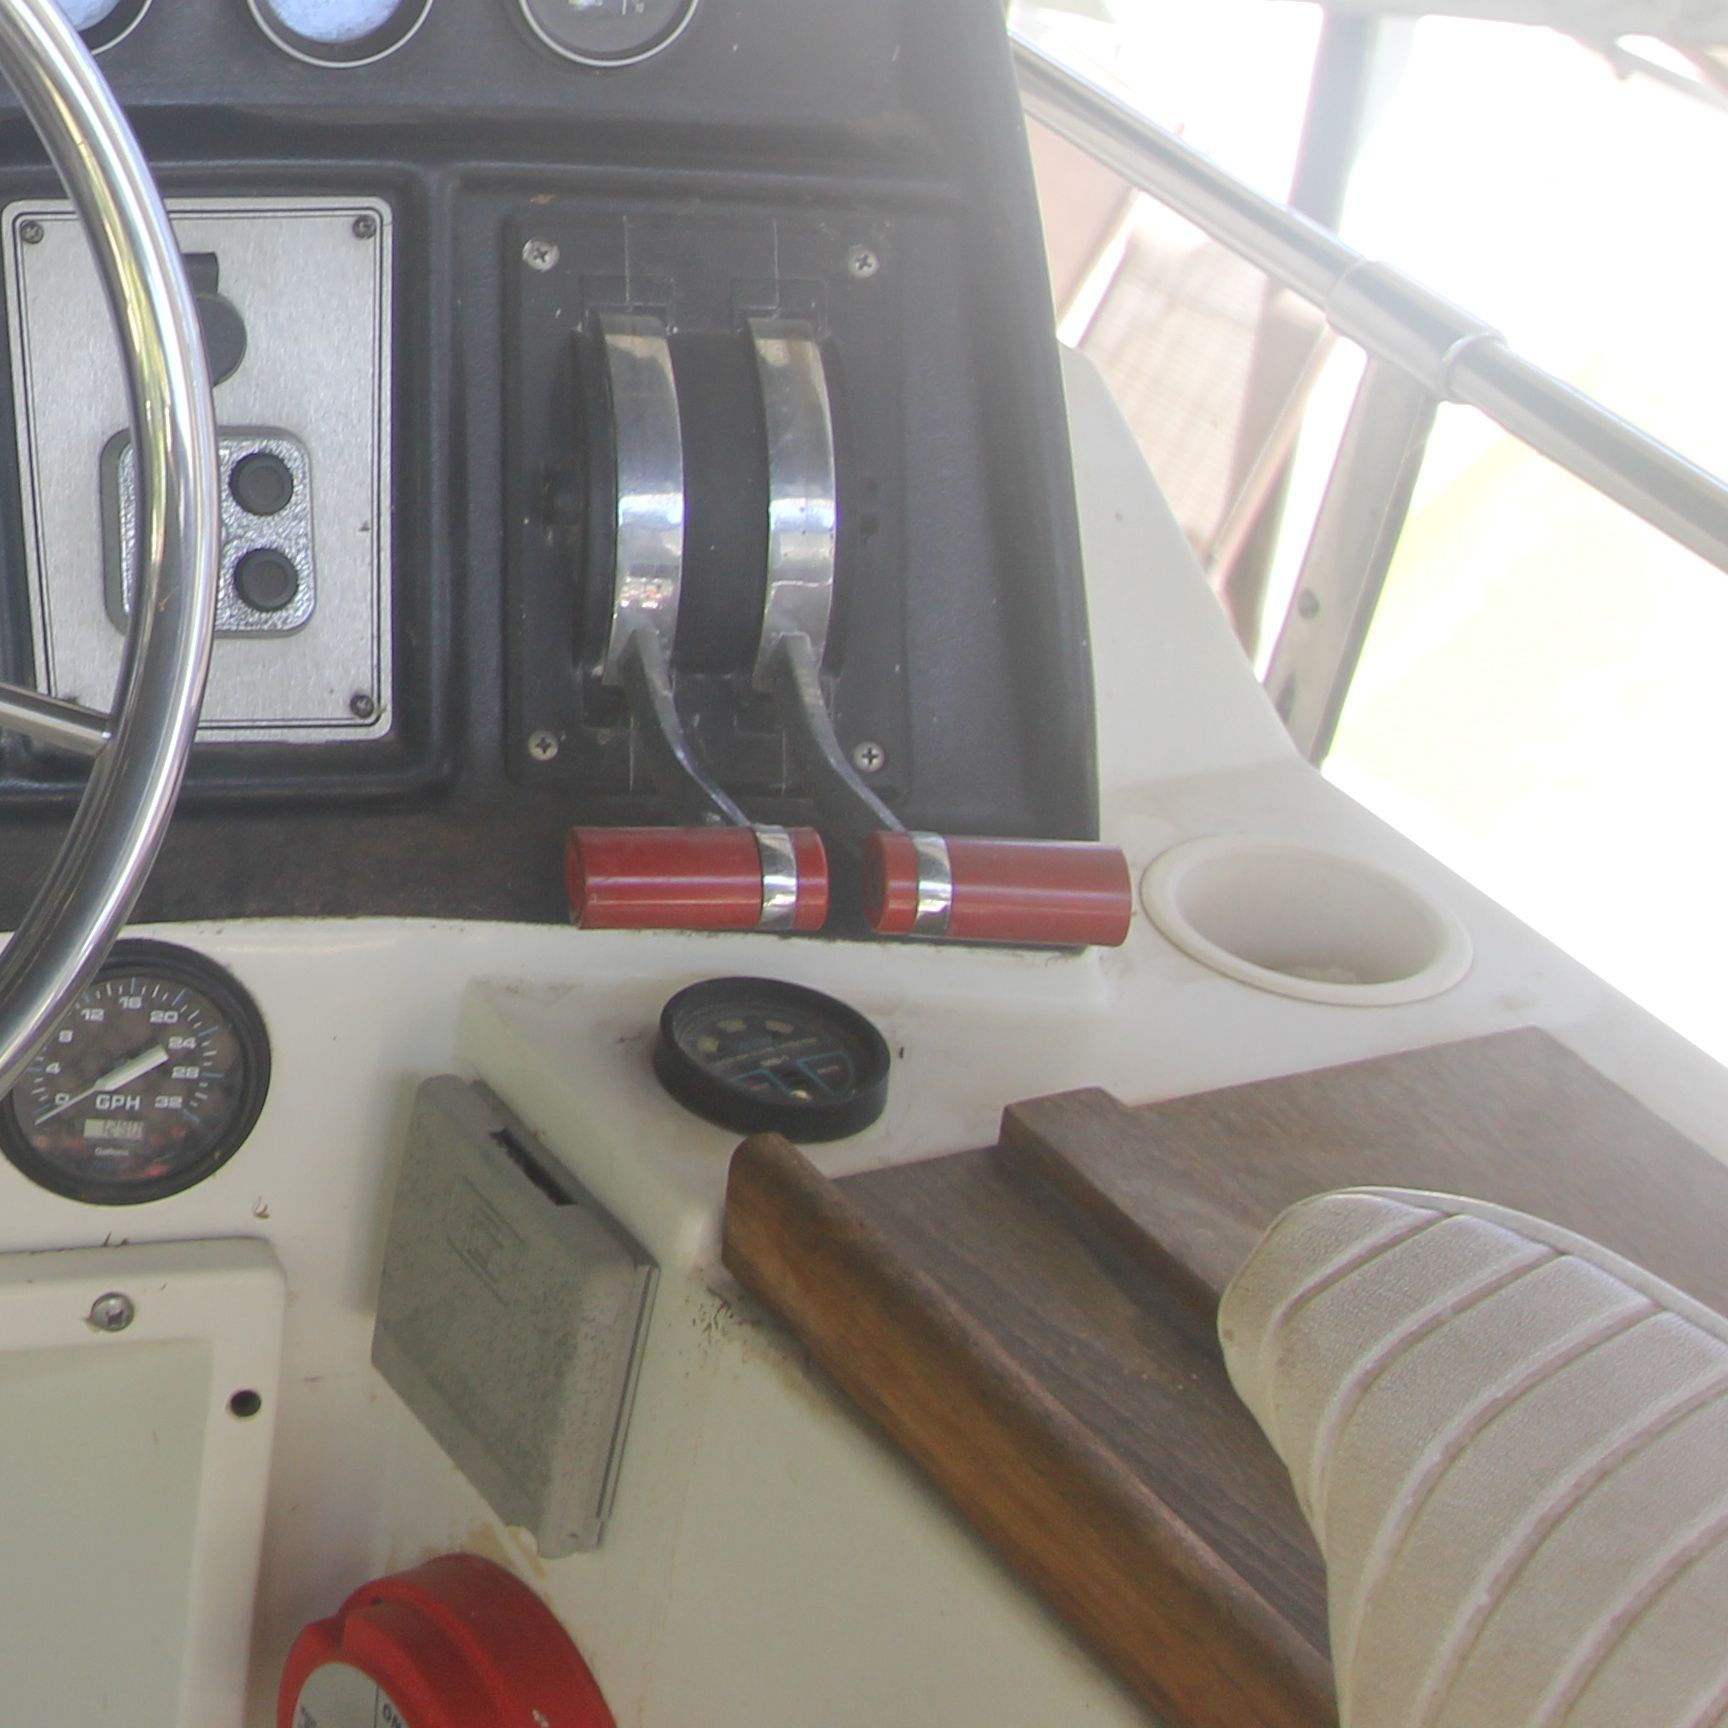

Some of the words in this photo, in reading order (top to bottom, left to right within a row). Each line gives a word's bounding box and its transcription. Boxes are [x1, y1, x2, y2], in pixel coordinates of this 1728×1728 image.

[118, 996, 142, 1009] 16
[80, 1008, 105, 1022] 12
[149, 1010, 179, 1023] 20
[58, 1030, 73, 1043] 8
[168, 1036, 196, 1049] 24
[46, 1062, 61, 1074] 4
[171, 1066, 200, 1079] 28
[95, 1095, 140, 1111] GPH
[154, 1095, 183, 1109] 32
